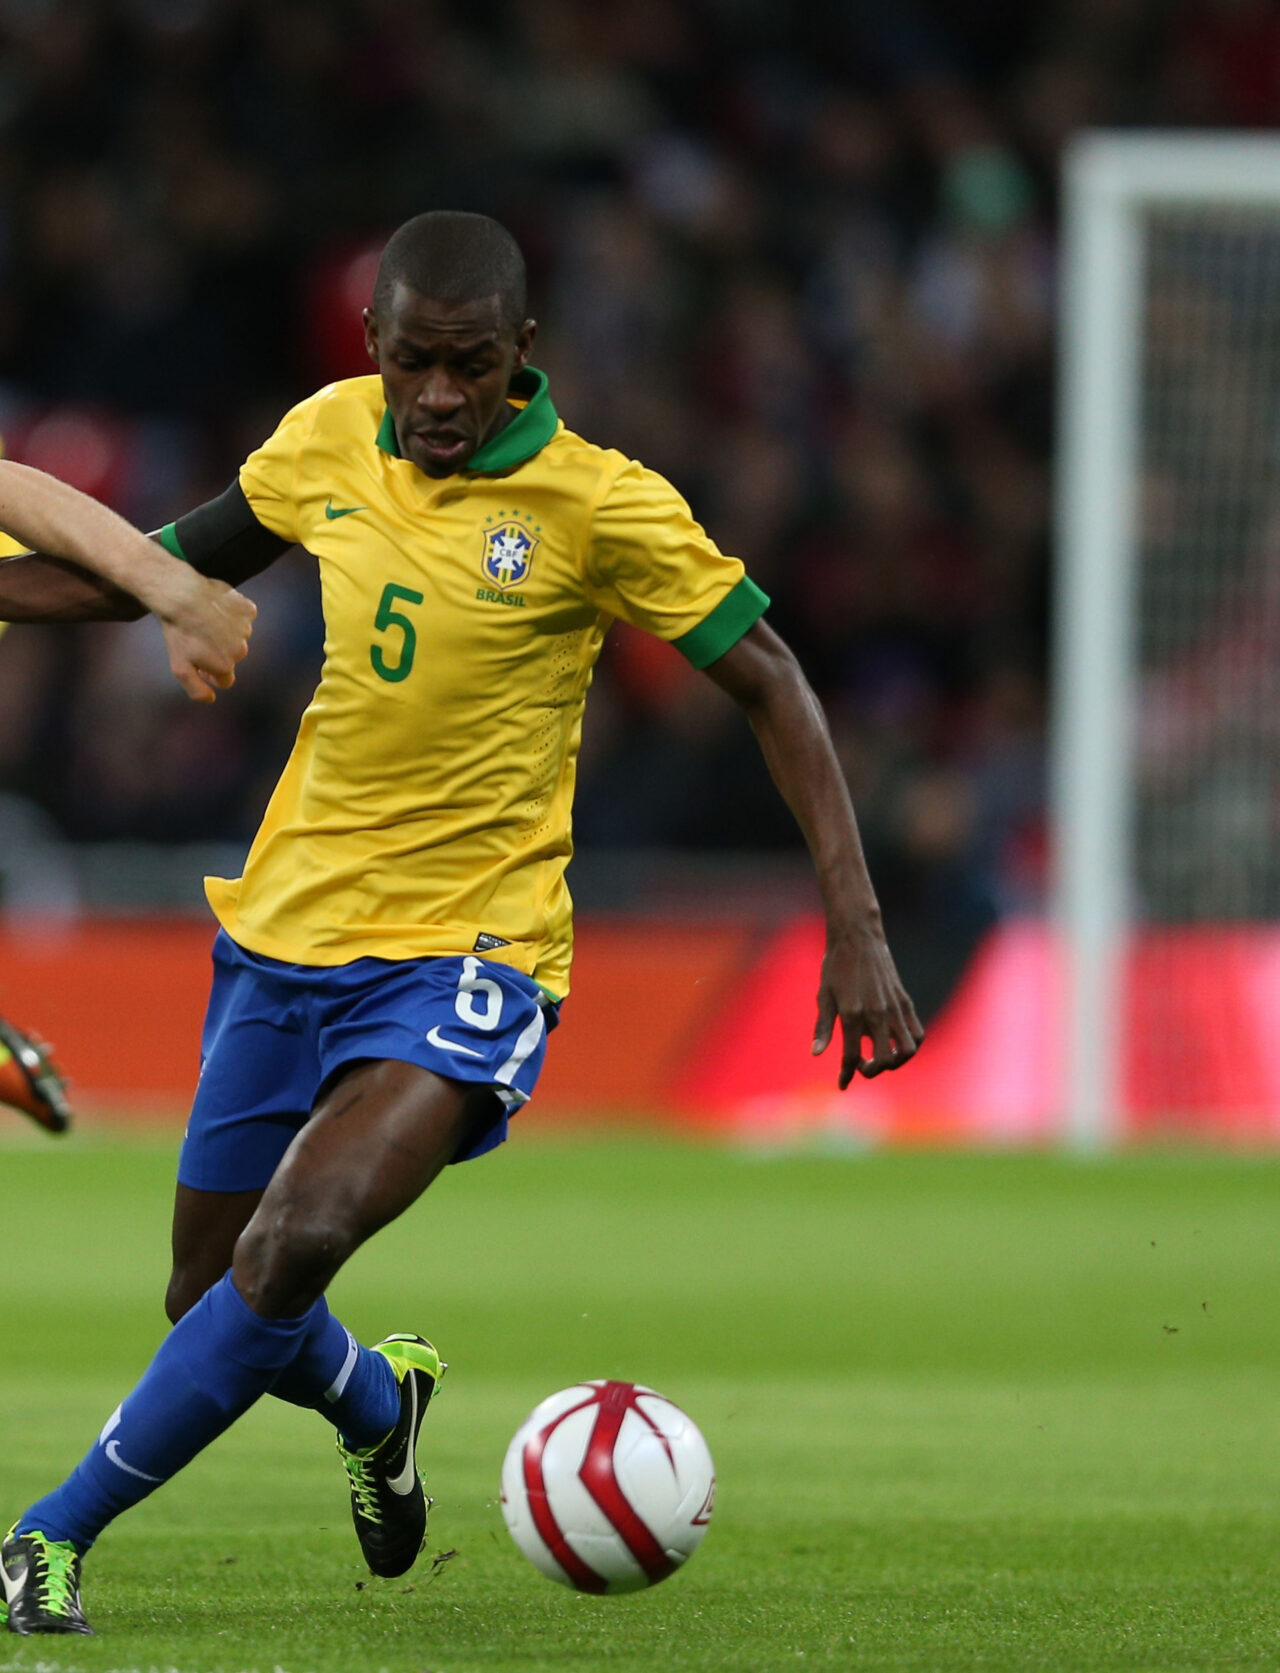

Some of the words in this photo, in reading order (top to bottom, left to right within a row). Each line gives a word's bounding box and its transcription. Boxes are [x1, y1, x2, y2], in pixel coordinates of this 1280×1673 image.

[499, 548, 518, 557] CBF
[476, 588, 527, 607] BRASIL
[370, 582, 424, 683] 5
